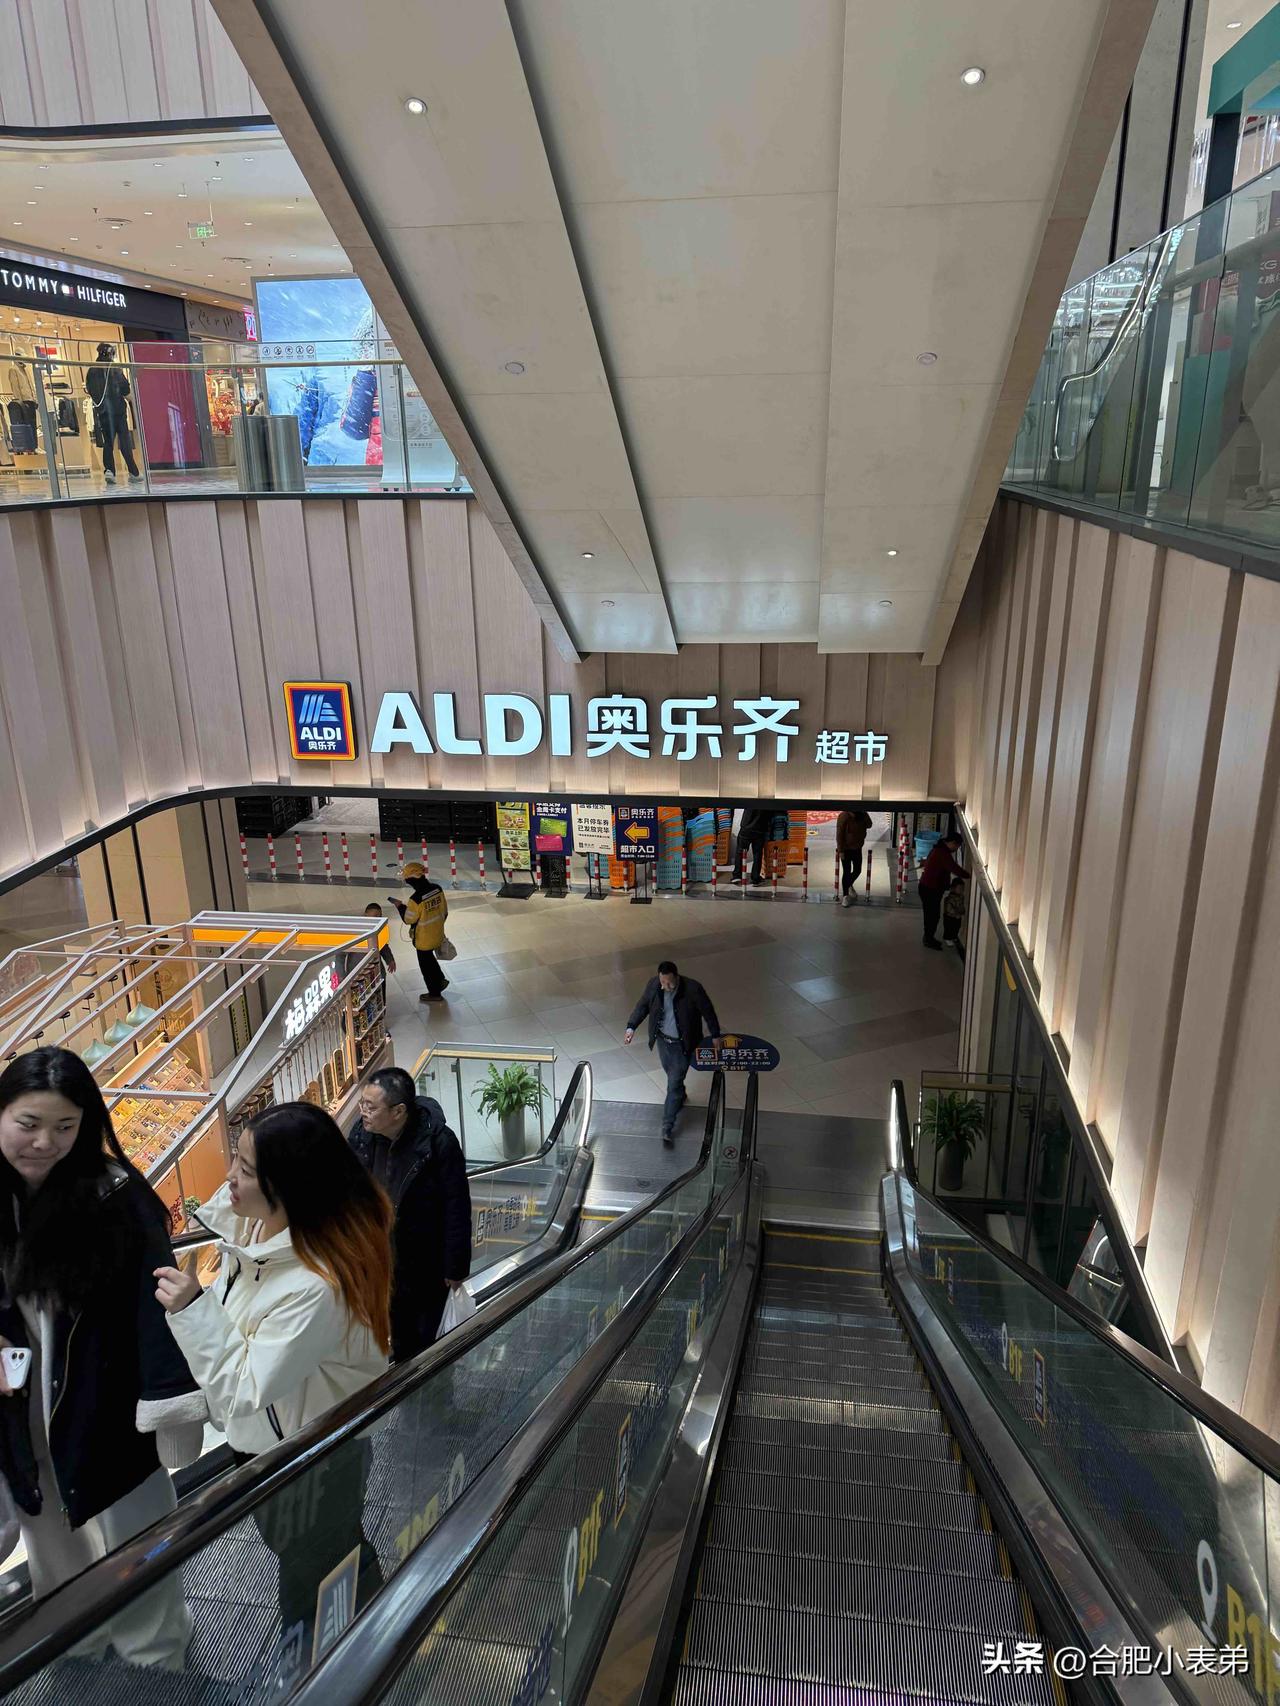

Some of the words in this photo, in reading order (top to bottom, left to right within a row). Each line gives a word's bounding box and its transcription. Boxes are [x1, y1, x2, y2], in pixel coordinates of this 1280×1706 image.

[1, 270, 58, 295] TOMMY
[77, 285, 126, 308] HILFIGER
[300, 726, 342, 741] ALDI
[371, 692, 572, 758] ALDI
[586, 694, 800, 763] 奥乐齐
[815, 730, 889, 766] 超市
[309, 741, 337, 751] 奥乐齐
[631, 808, 655, 816] 奥乐齐
[577, 818, 609, 826] 本月停车券
[577, 825, 610, 833] 已发放完毕
[620, 845, 655, 853] 超市入口
[721, 1048, 769, 1057] 奥乐齐
[1009, 1337, 1023, 1385] B1F
